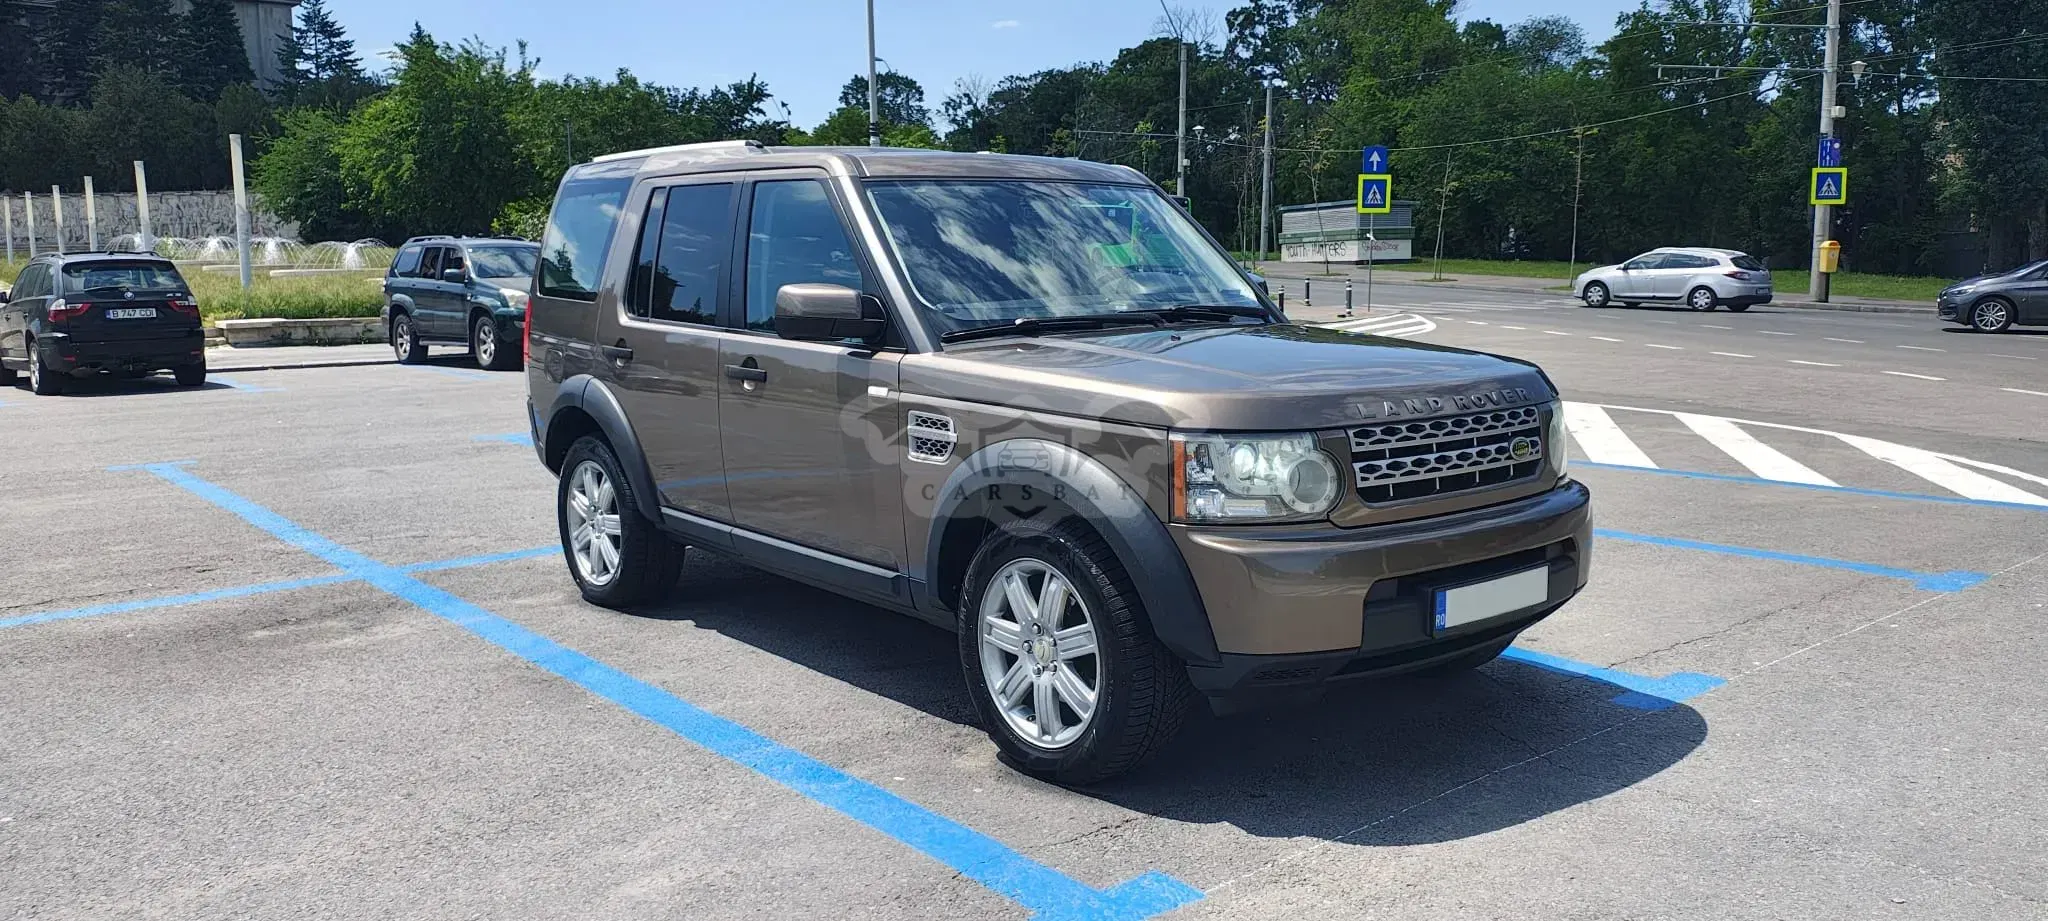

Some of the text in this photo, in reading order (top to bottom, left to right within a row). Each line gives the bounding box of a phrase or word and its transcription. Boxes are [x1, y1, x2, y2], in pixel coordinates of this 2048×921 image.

[112, 310, 119, 318] B
[121, 309, 137, 317] 747
[1356, 387, 1530, 419] LAND ROVER
[1435, 613, 1446, 629] RO
